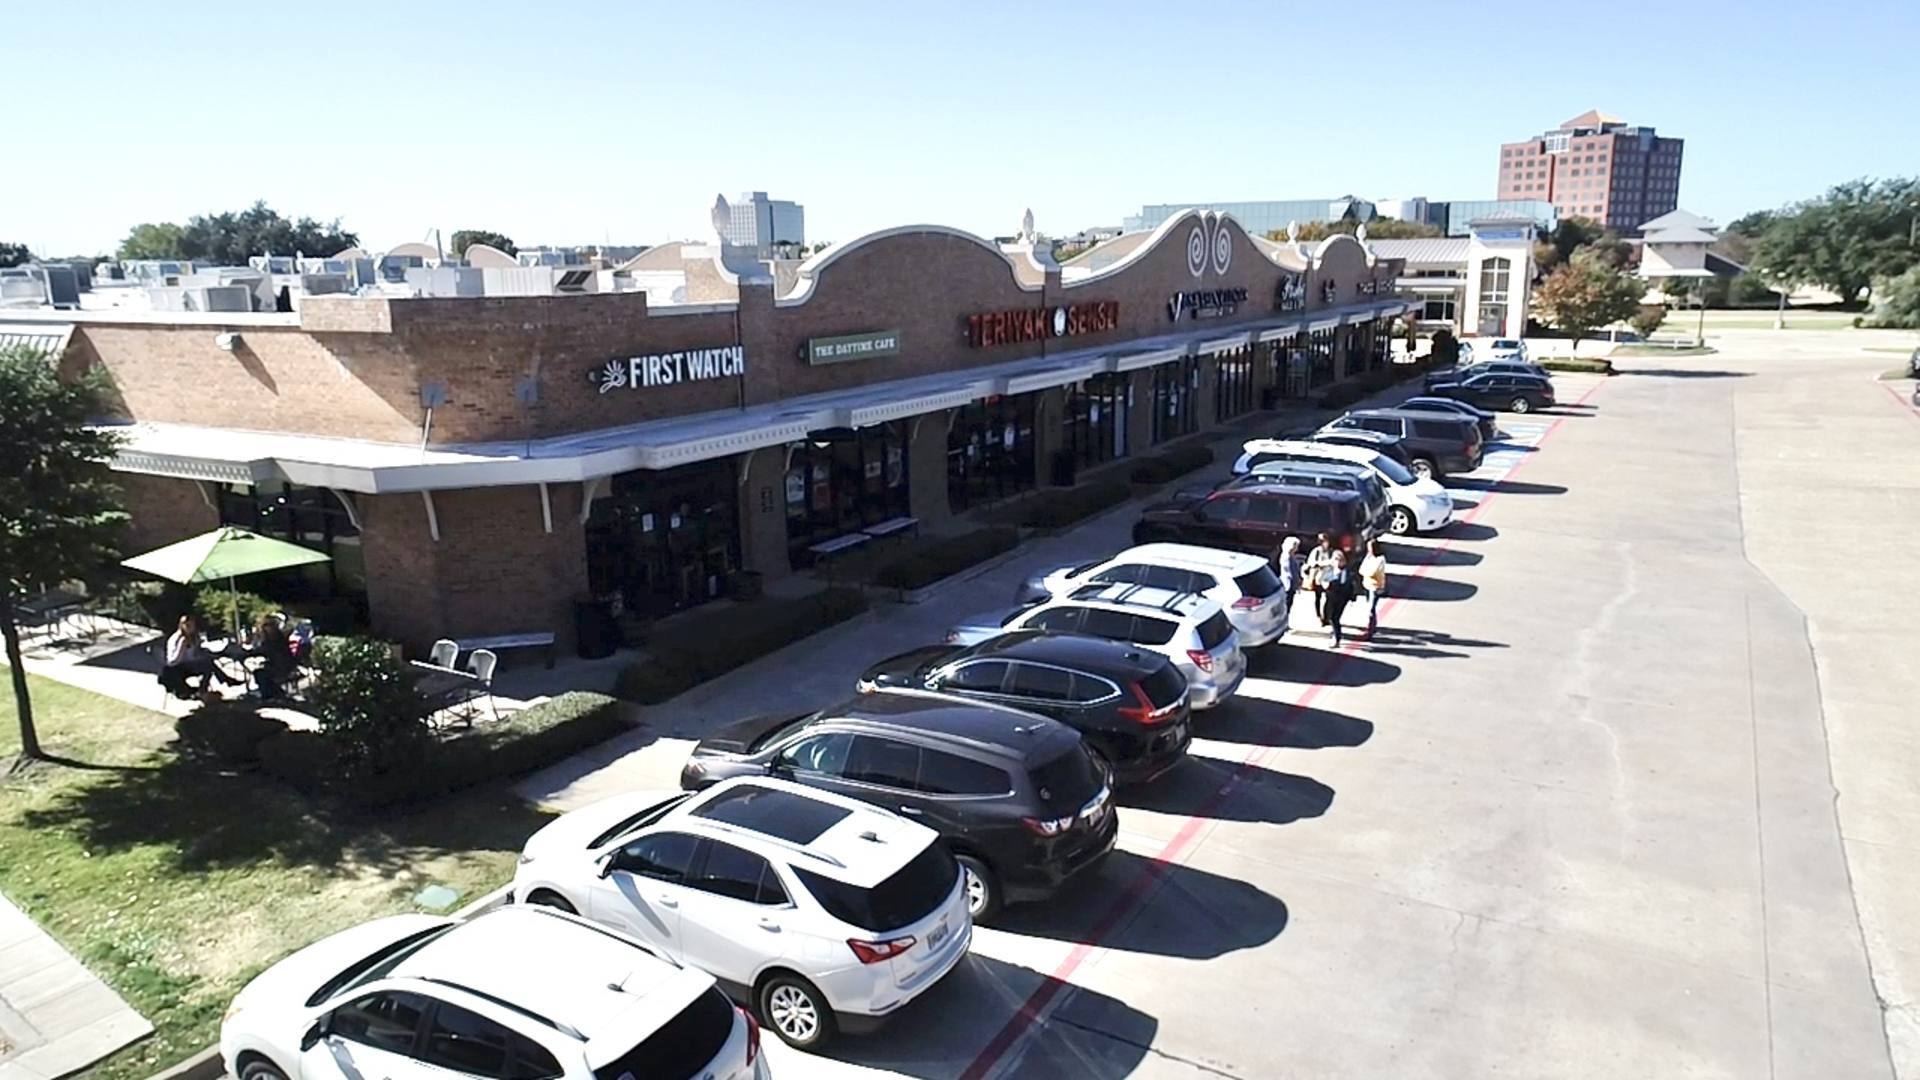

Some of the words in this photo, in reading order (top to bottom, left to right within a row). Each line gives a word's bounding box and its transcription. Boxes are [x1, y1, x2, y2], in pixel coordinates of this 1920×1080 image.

[815, 344, 834, 357] THE
[836, 340, 873, 355] DAYTIME
[874, 337, 895, 350] CAFE
[629, 352, 684, 388] FIRST
[686, 346, 744, 381] WATCH
